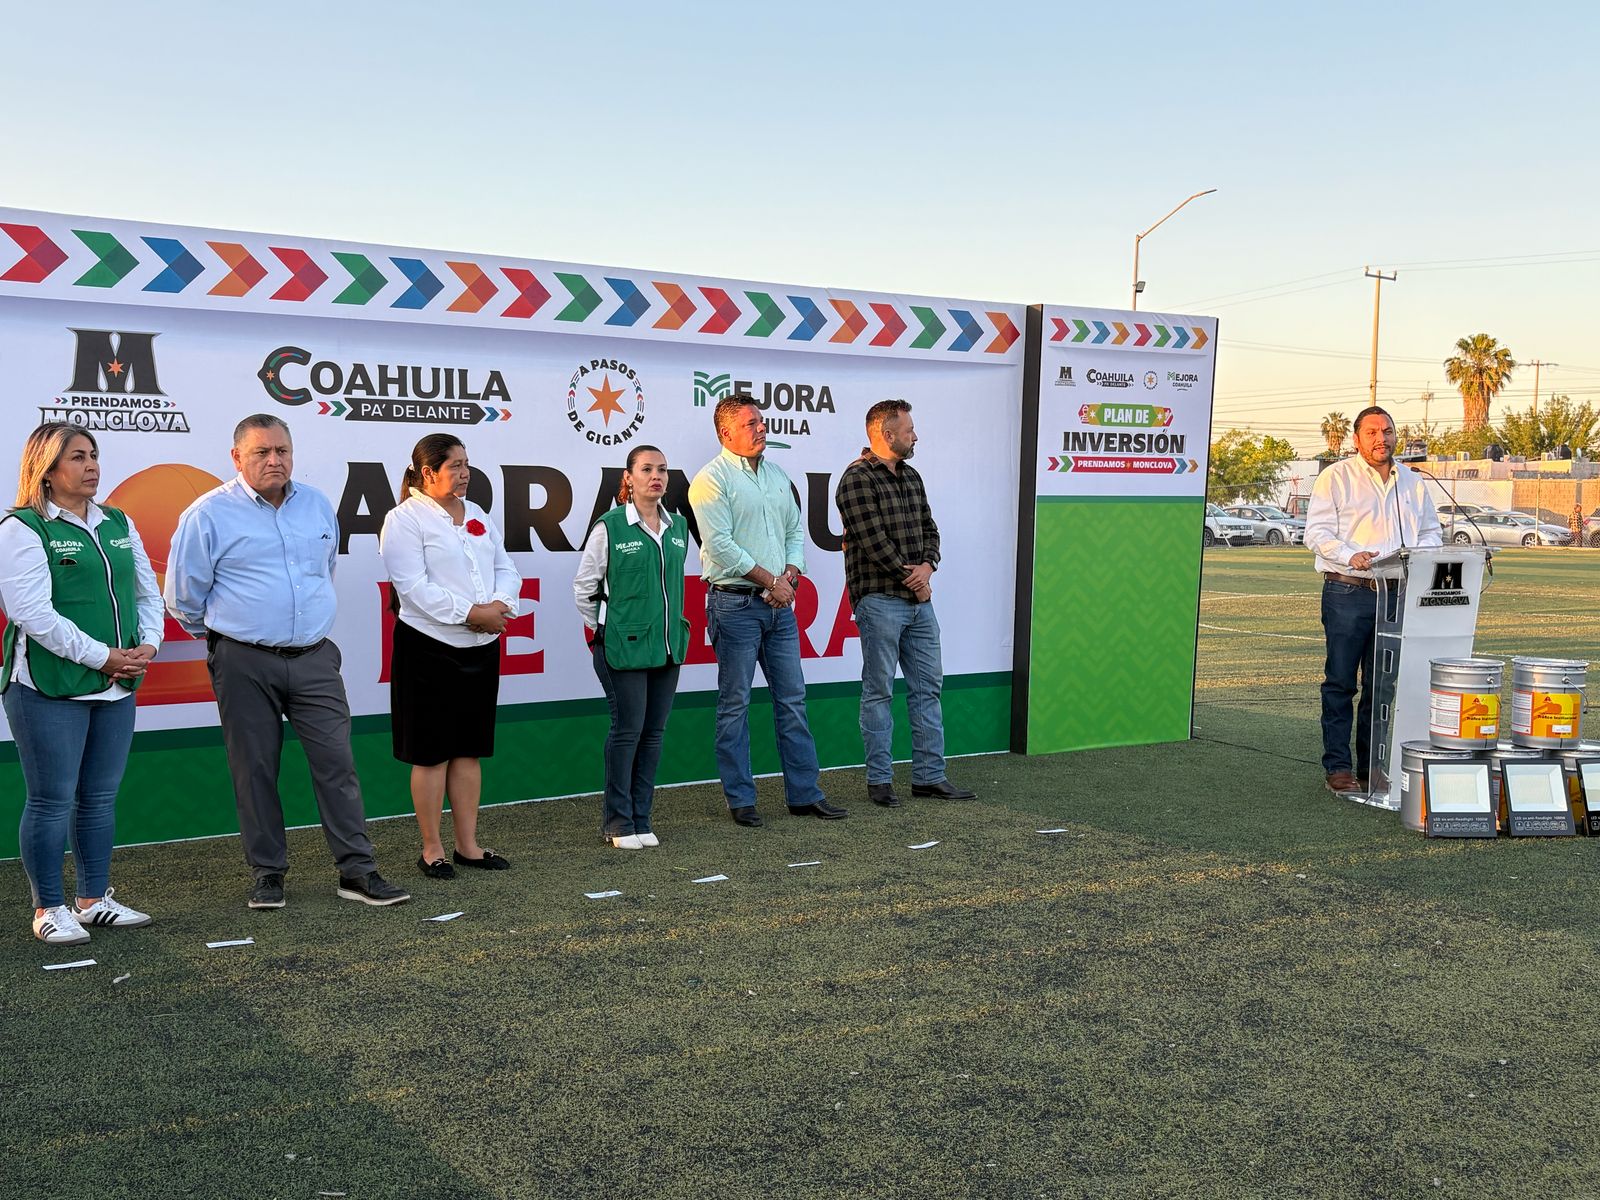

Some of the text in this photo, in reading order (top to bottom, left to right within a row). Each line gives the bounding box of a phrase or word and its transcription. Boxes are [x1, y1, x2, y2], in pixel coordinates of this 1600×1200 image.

[257, 346, 512, 406] COAHUILA
[579, 359, 636, 380] A PASOS
[1086, 369, 1134, 383] COAHUILA
[71, 396, 161, 409] PRENDAMOS
[41, 407, 190, 433] MONCLOVA
[392, 404, 471, 420] DELANTE
[1104, 408, 1149, 424] PLAN DE
[567, 410, 645, 446] DE GIGANTE
[1062, 428, 1185, 454] INVERSIÓN
[1077, 460, 1173, 470] PRENDAMOS MONCLOVA
[49, 540, 84, 549] MEJORA
[615, 540, 643, 551] MEJORA
[1419, 596, 1470, 607] MONCLOVA
